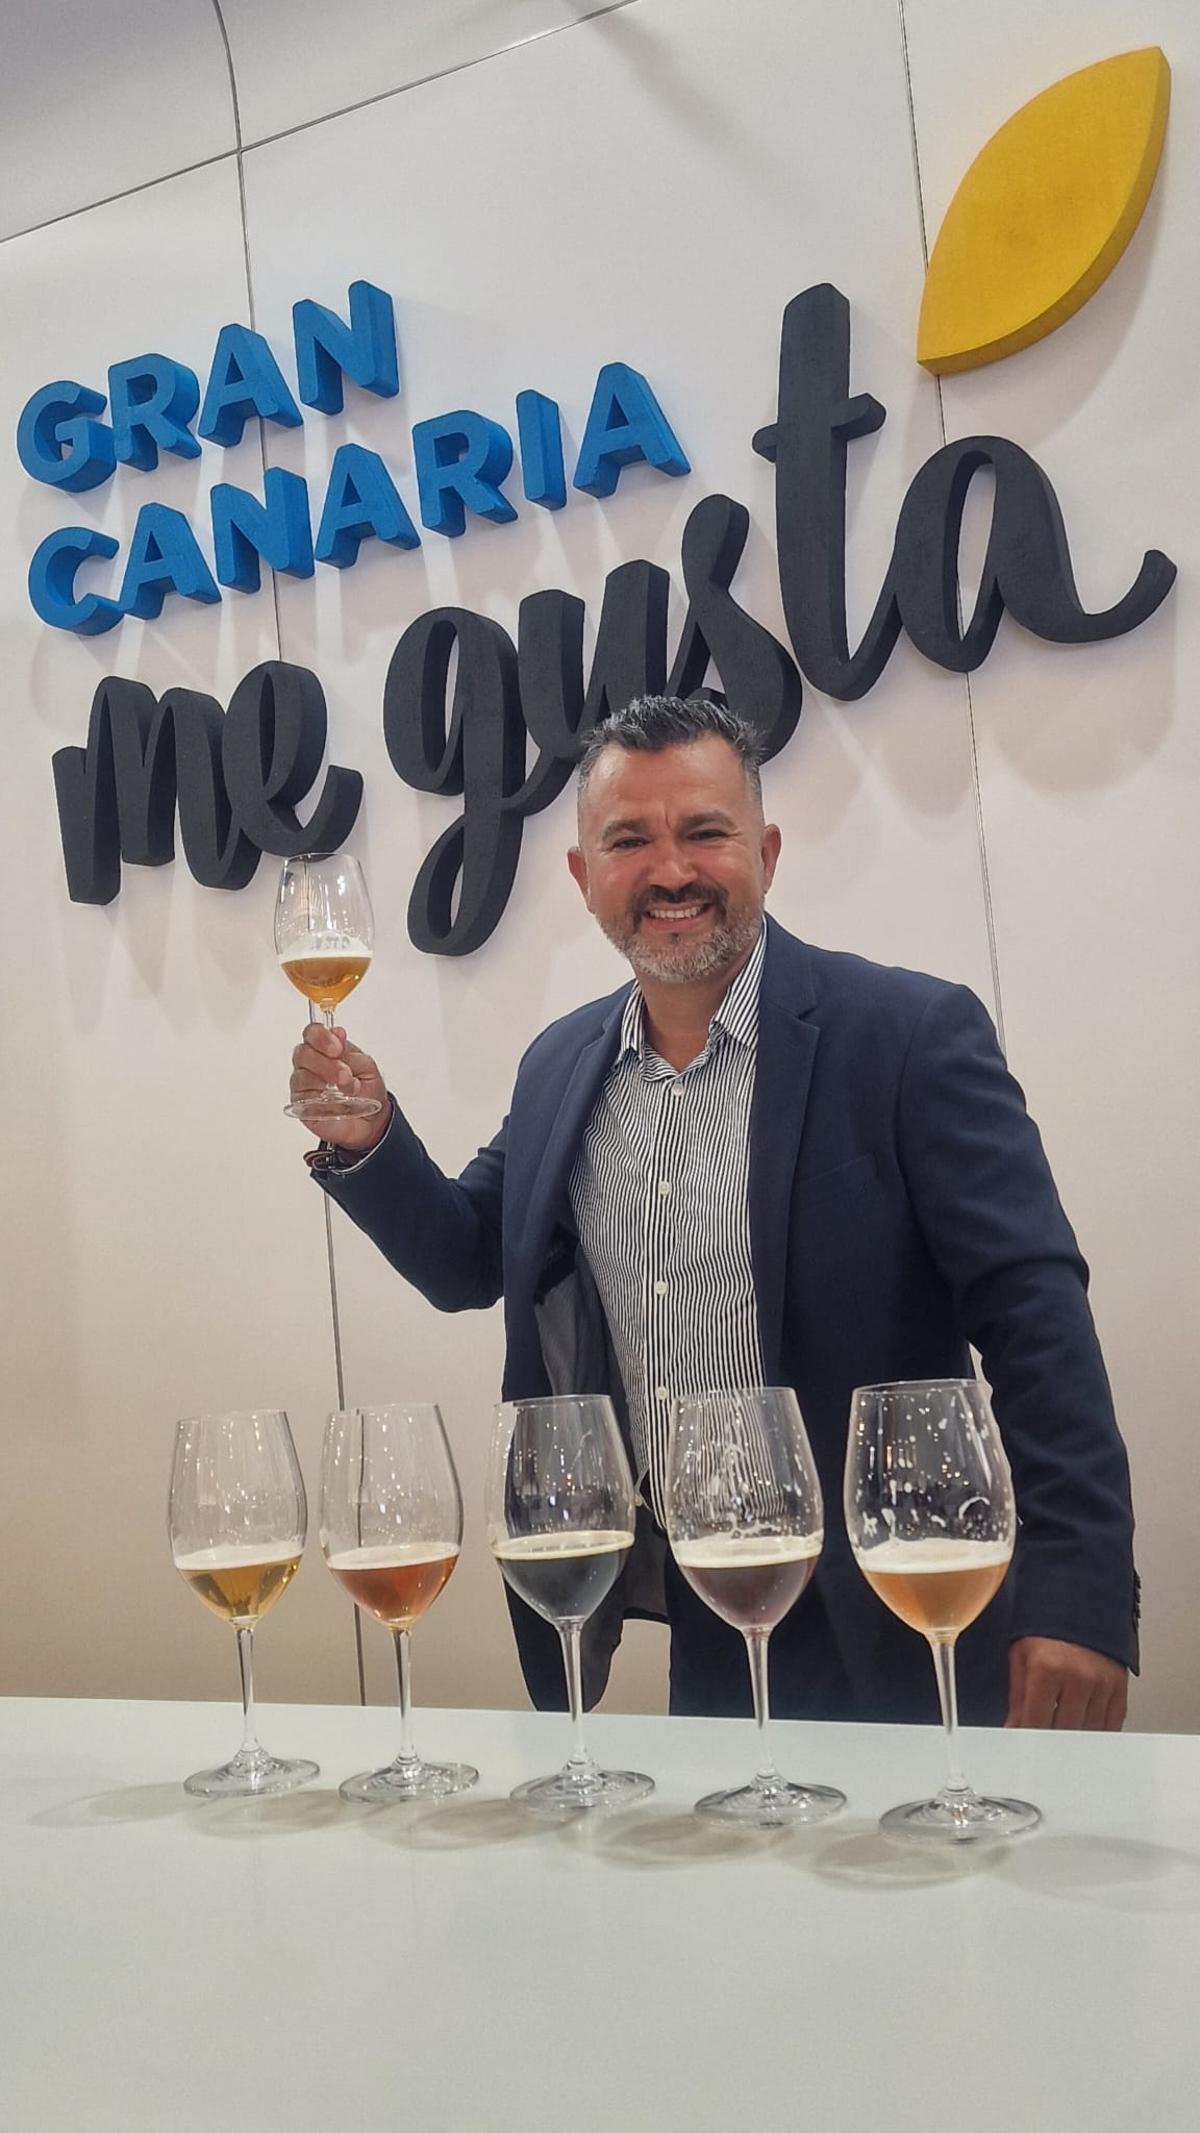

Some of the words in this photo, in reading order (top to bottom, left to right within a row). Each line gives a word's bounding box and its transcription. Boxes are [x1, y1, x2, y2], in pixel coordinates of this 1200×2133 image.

[18, 281, 401, 493] GRAN
[28, 363, 692, 635] CANARIA
[52, 660, 364, 906] me
[384, 283, 1178, 957] gusta
